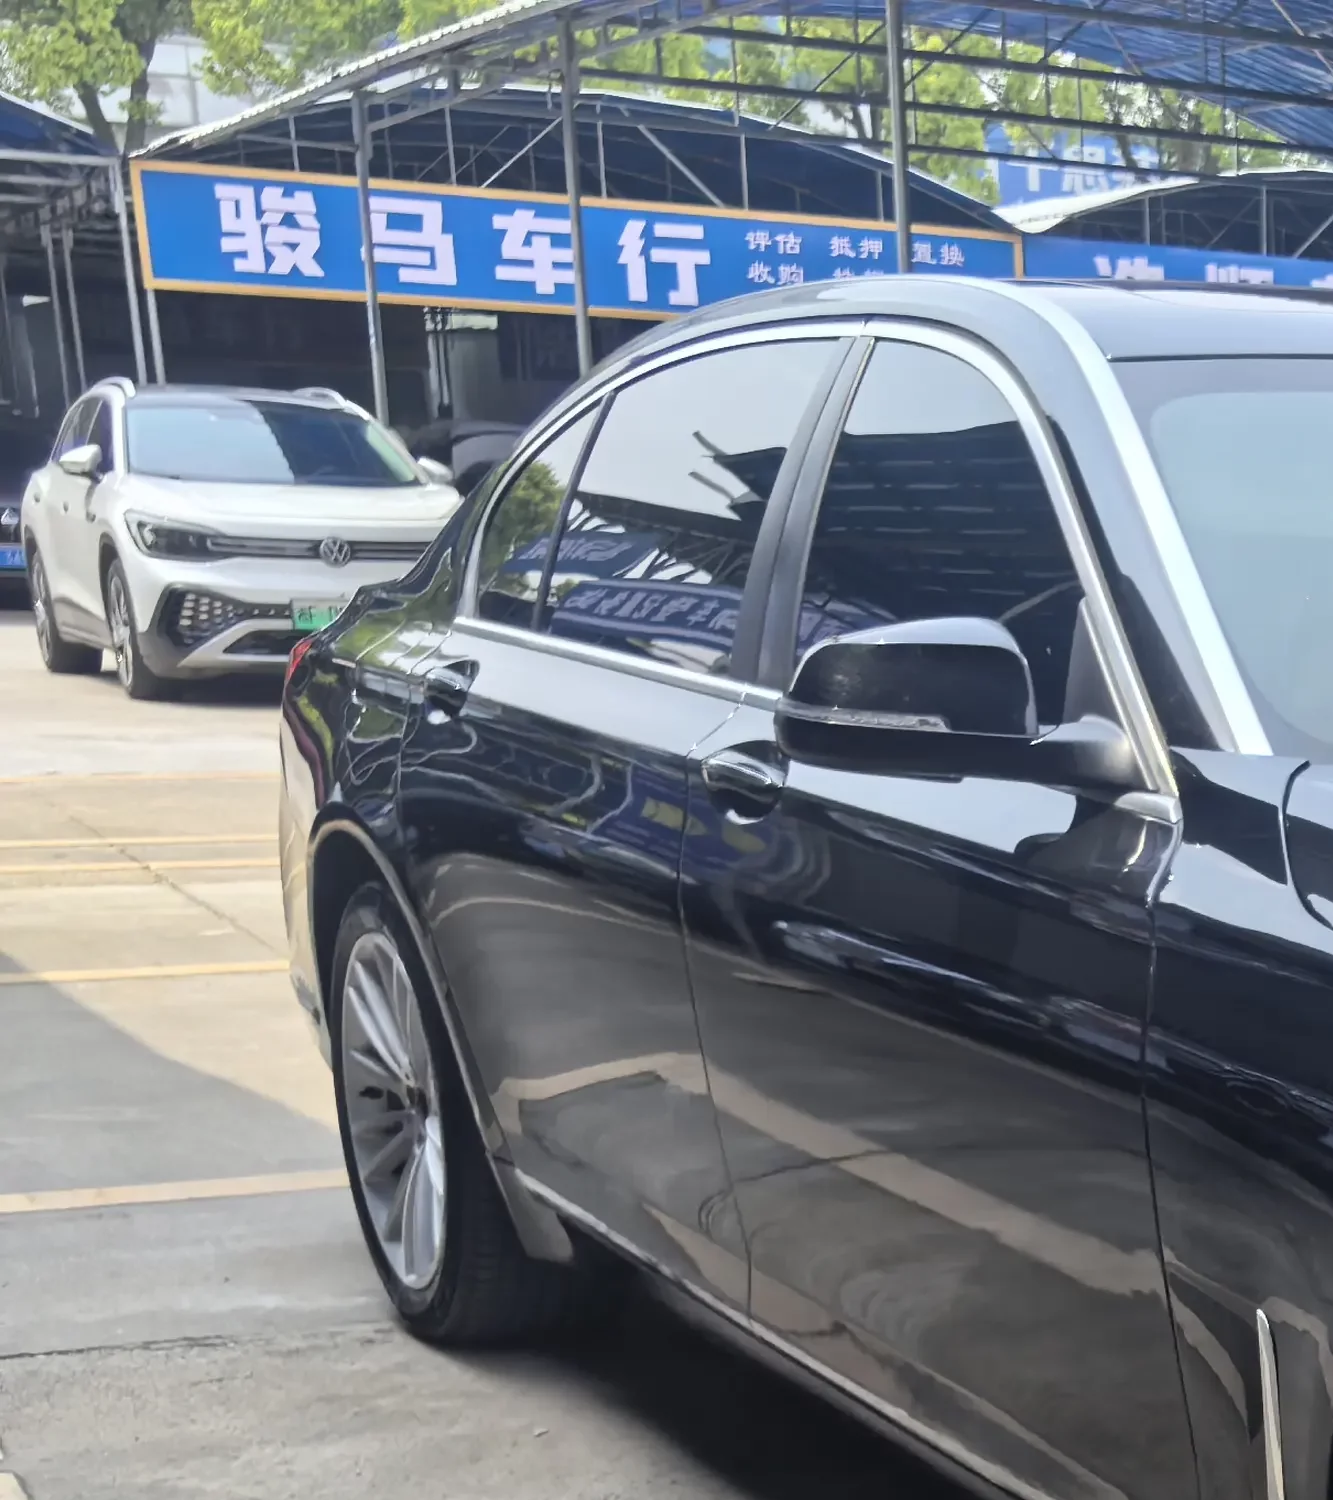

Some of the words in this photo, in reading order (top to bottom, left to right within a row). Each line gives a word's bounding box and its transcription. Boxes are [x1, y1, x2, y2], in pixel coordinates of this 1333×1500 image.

[214, 183, 712, 307] 骏马车行
[745, 229, 802, 255] 评估
